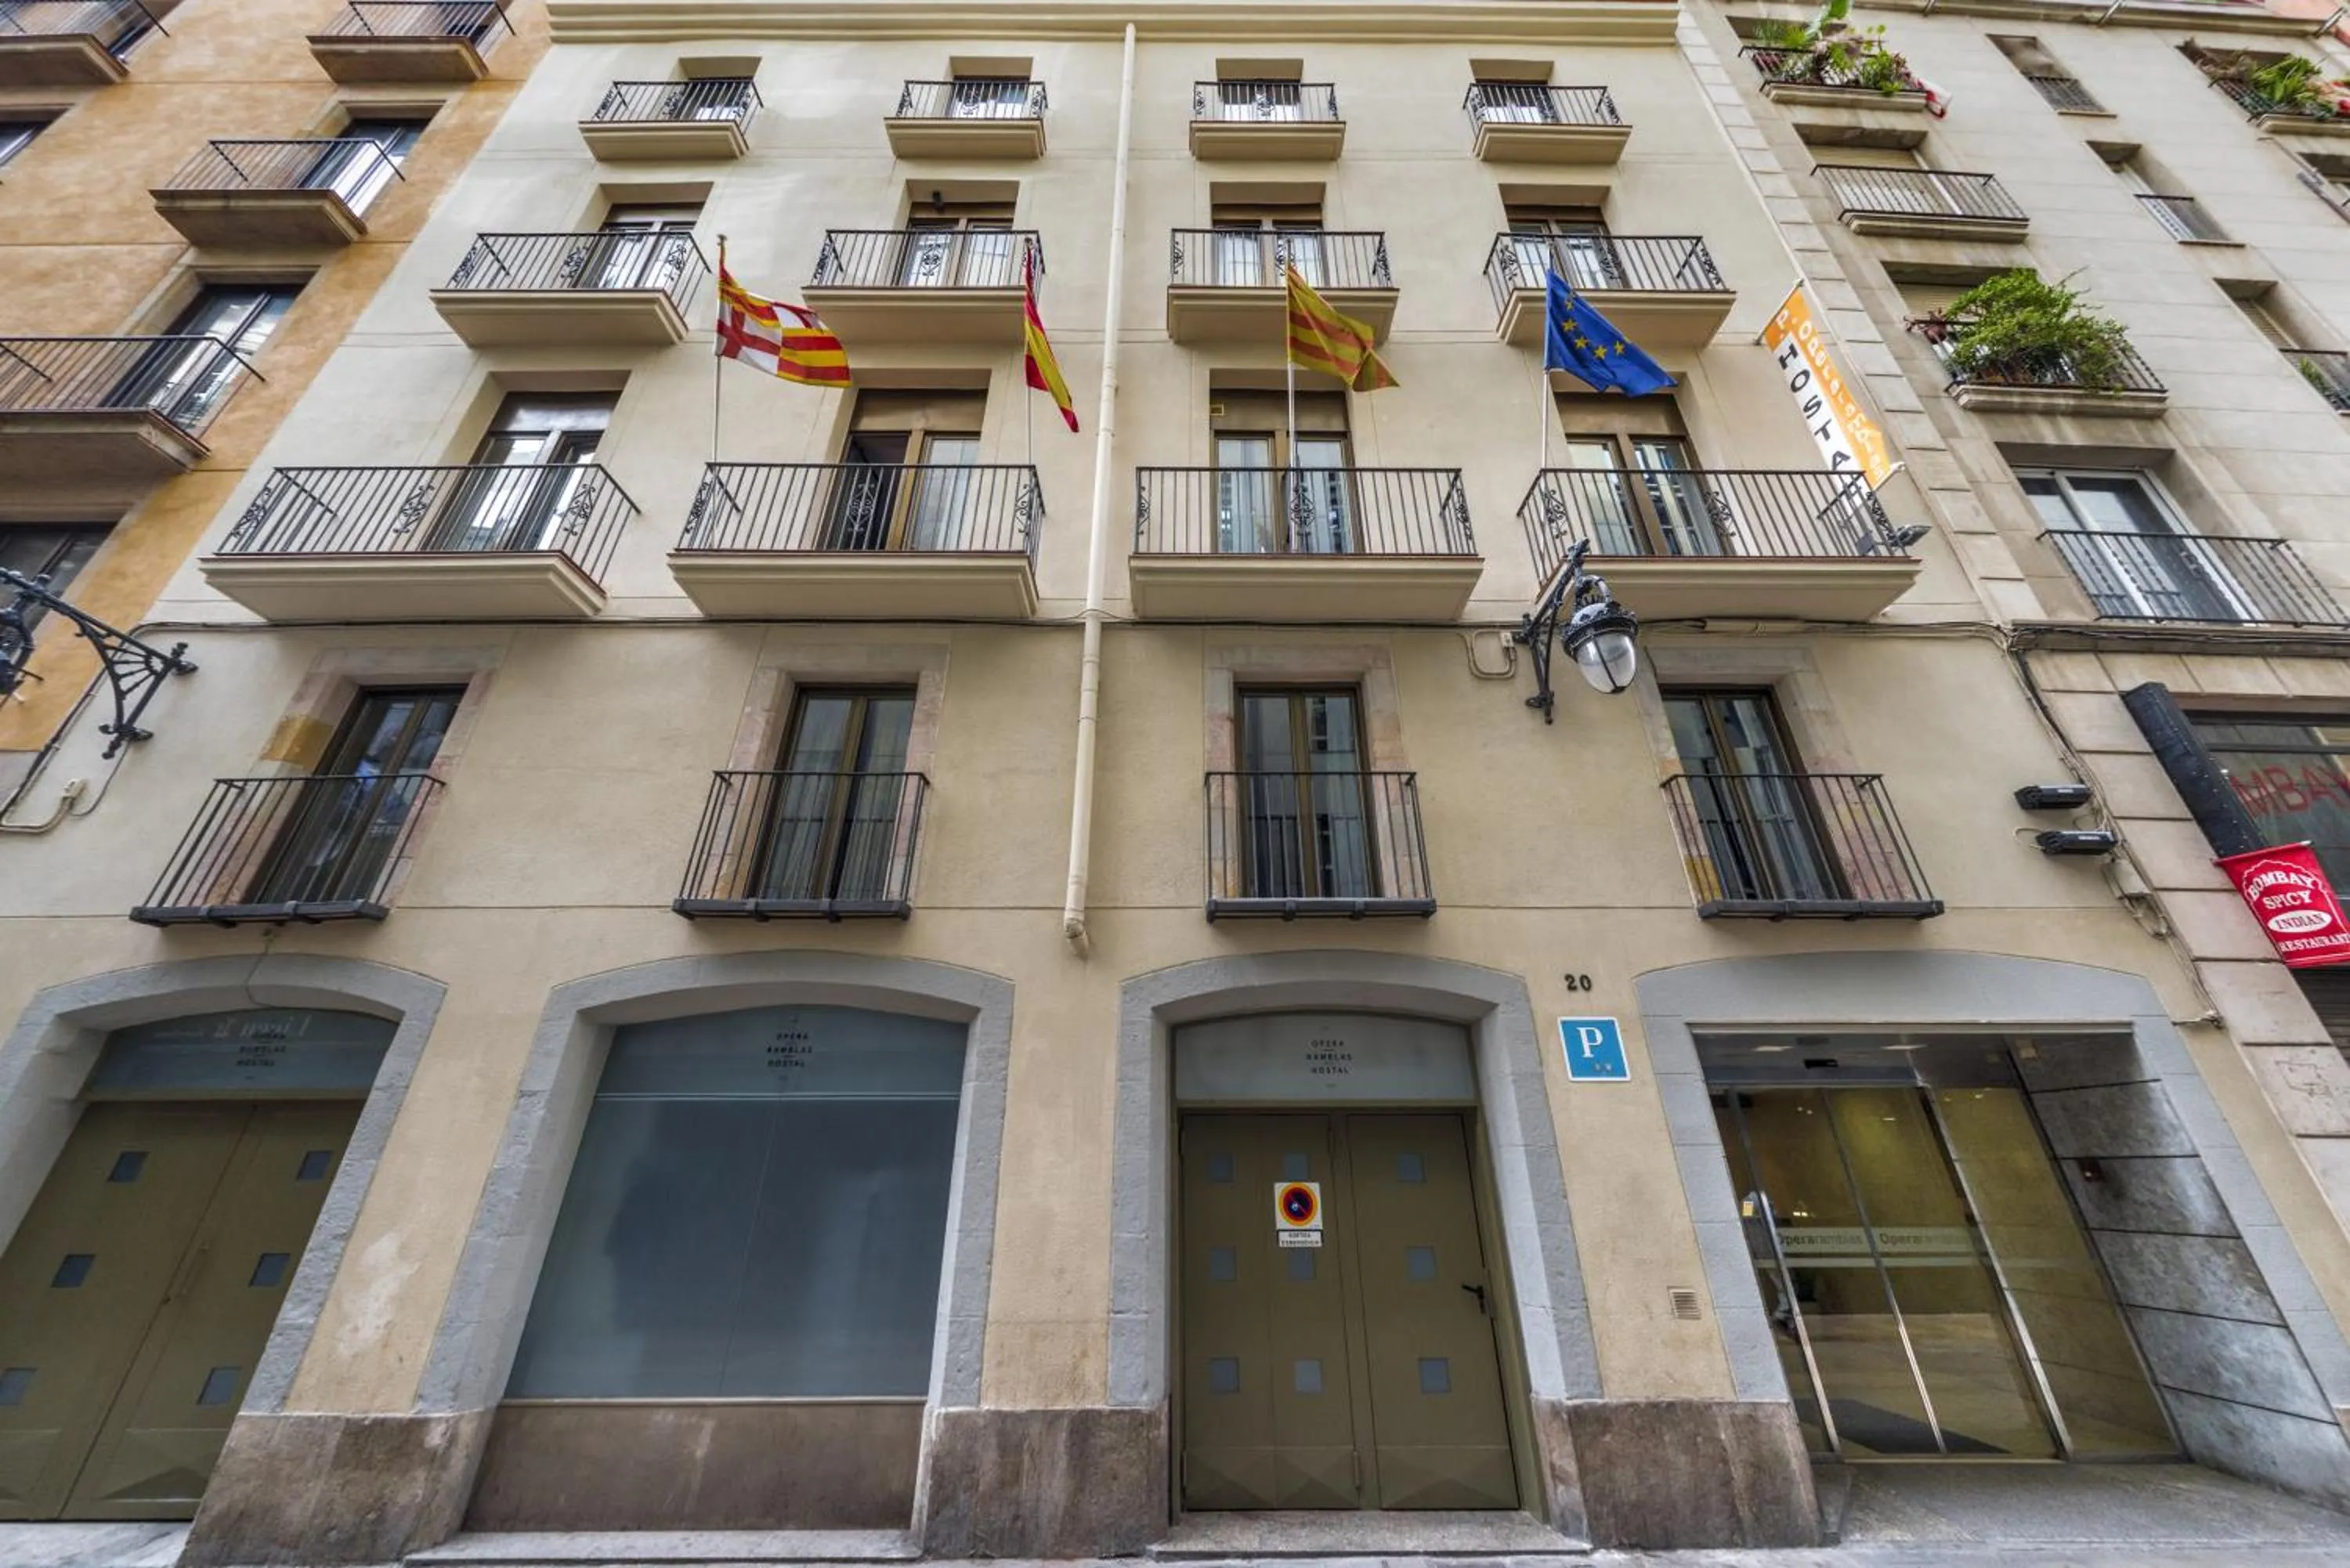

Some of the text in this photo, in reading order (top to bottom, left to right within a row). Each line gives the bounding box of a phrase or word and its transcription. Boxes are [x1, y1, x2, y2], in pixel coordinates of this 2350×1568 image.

[2247, 870, 2316, 901] BOMBAY
[2262, 890, 2313, 909] SPICY
[2274, 913, 2326, 930] INDIAN
[1564, 974, 1593, 992] 20
[1310, 1039, 1345, 1049] OPERA
[1576, 1027, 1603, 1058] P
[1305, 1053, 1353, 1061] RAMBLAS
[1311, 1066, 1350, 1075] HOSTAL
